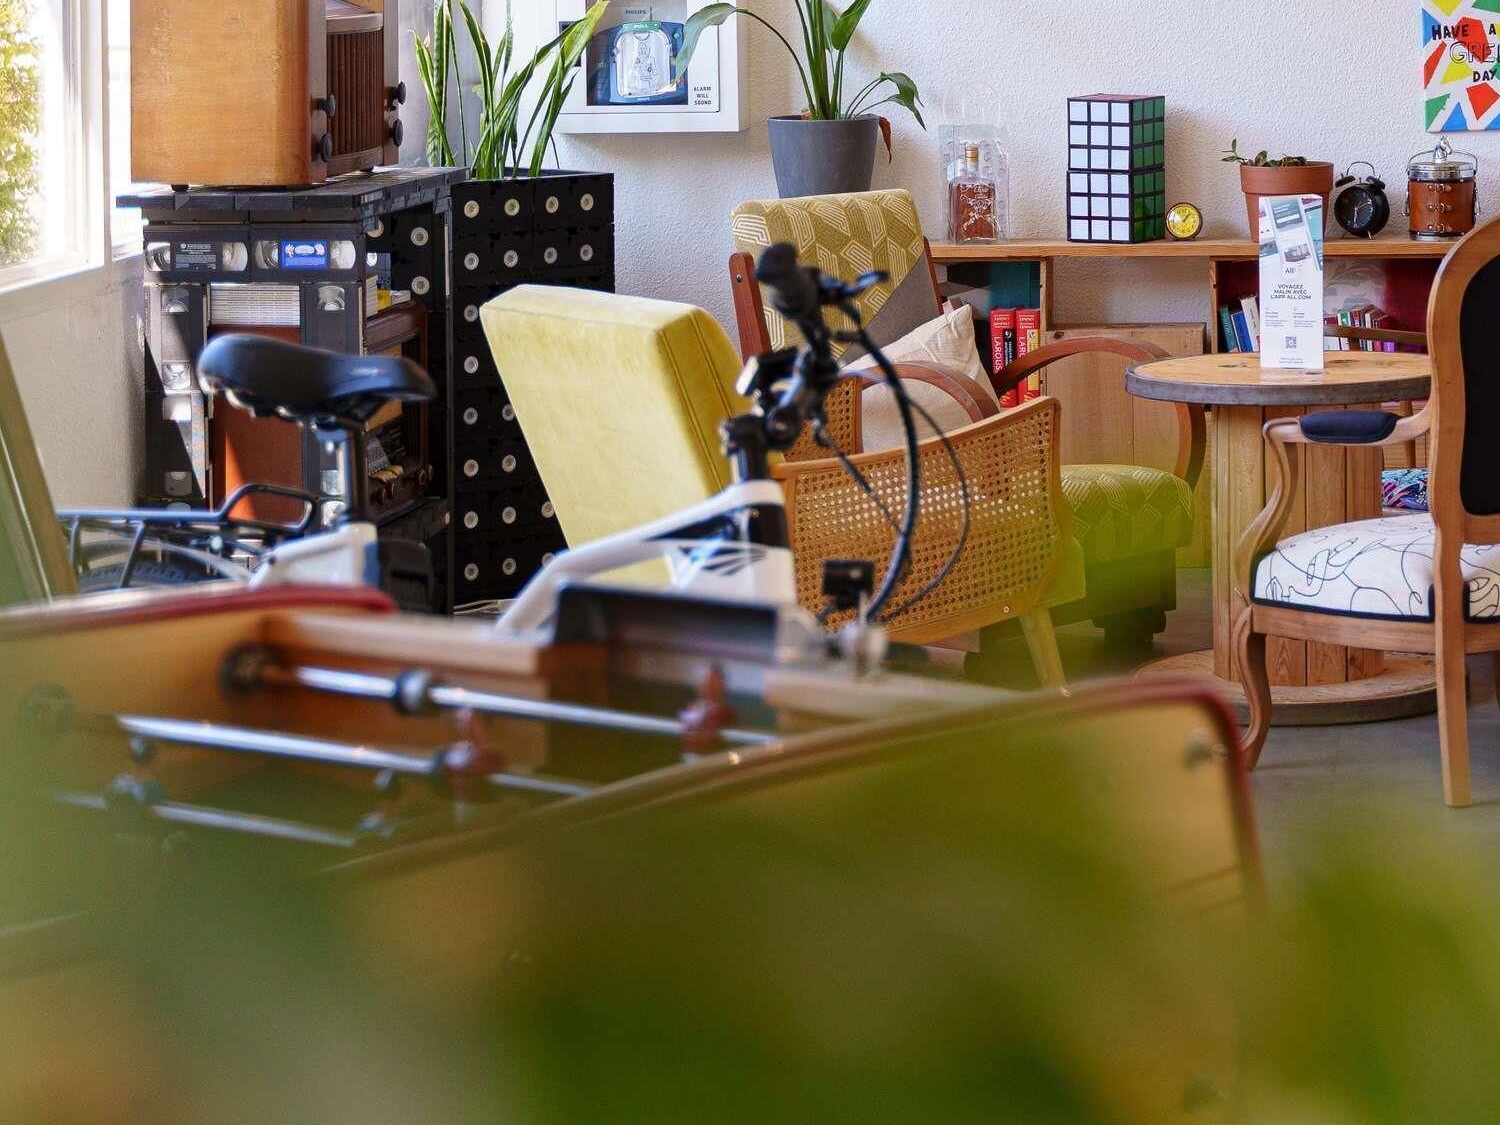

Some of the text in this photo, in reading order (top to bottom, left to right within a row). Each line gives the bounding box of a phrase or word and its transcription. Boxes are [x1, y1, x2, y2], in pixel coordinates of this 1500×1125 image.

[1431, 23, 1497, 41] HAVE A
[1472, 69, 1498, 83] DAY
